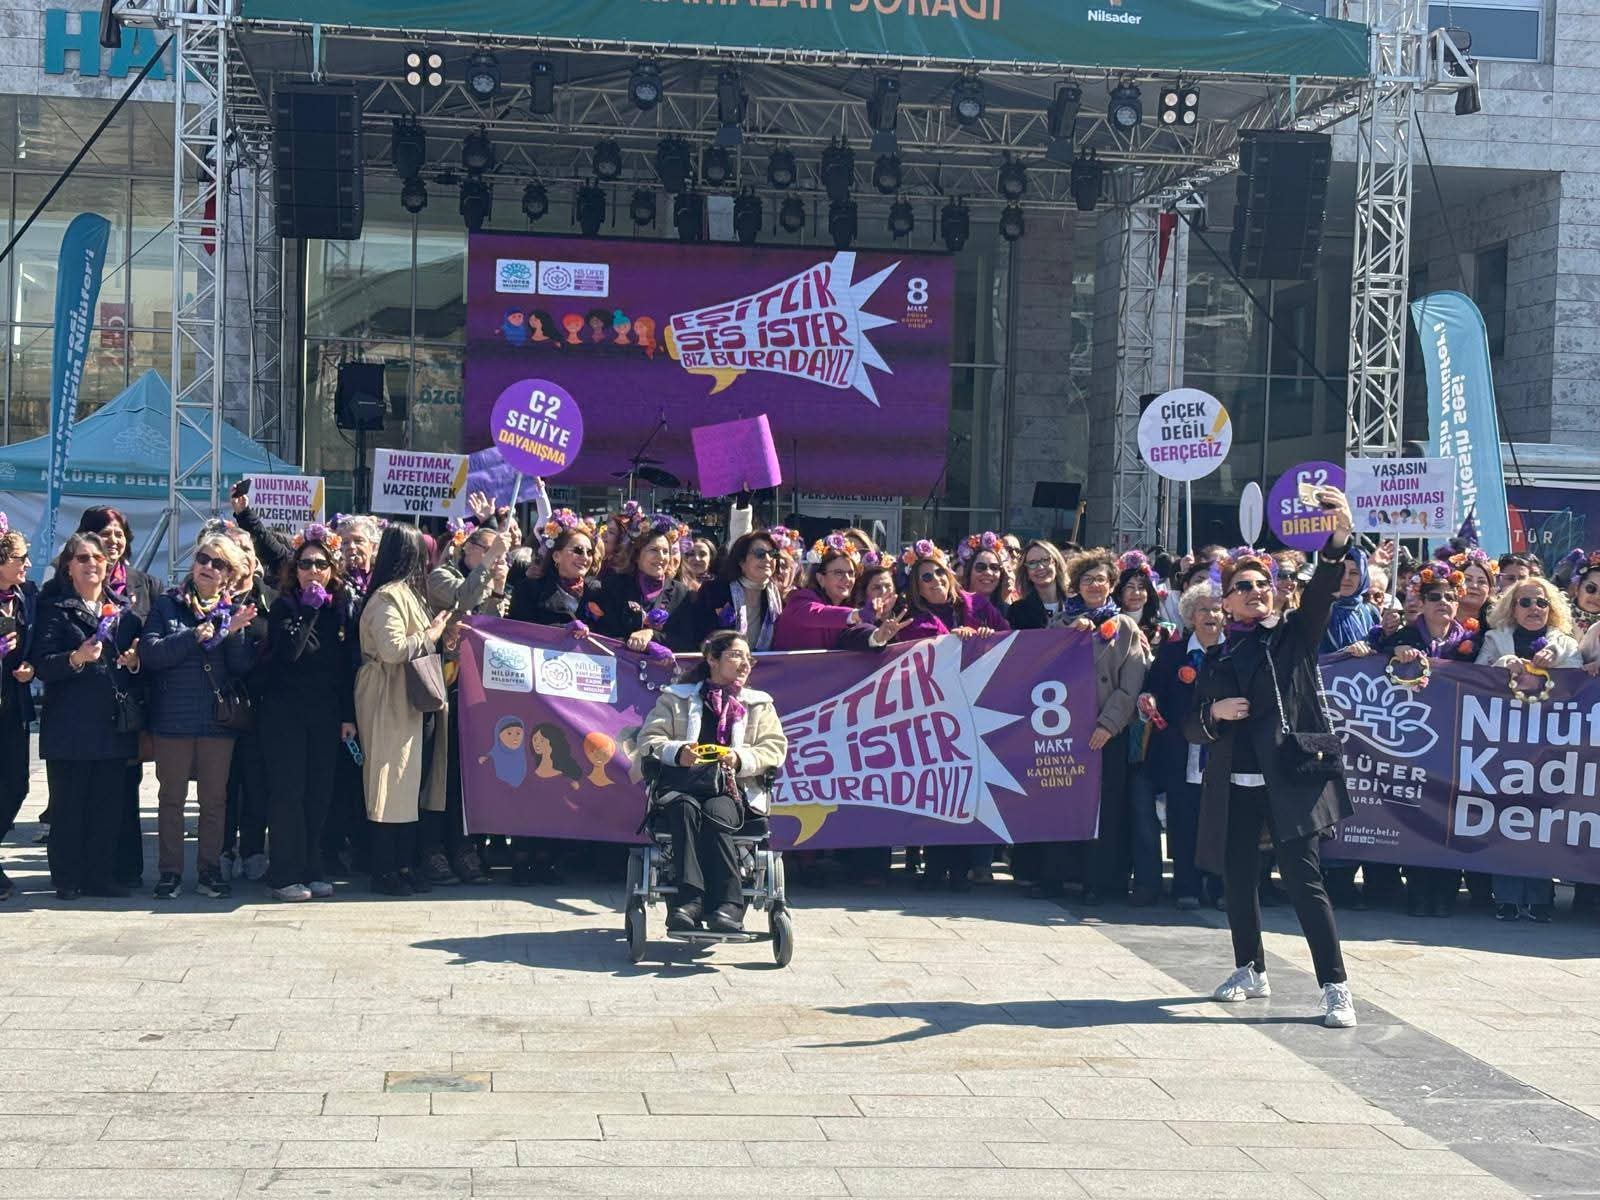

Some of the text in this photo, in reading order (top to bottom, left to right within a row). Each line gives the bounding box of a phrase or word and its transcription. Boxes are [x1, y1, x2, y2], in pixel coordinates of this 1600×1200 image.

[1087, 9, 1142, 24] Nilsader
[672, 264, 838, 331] EŞİTLİK
[906, 277, 929, 305] 8
[676, 311, 856, 352] SES İSTER
[682, 348, 855, 386] BİZ BURADAYIZ
[529, 390, 561, 420] C2
[1161, 401, 1206, 424] ÇİÇEK
[505, 409, 571, 448] SEVİYE
[1161, 420, 1208, 441] DEĞİL
[498, 429, 566, 466] DAYANIŞMA
[389, 454, 455, 471] UNUTMAK,
[1372, 462, 1427, 479] YAŞASIN
[40, 469, 117, 484] NLÜFER
[387, 469, 454, 485] AFFETMEK,
[1380, 478, 1419, 491] KADIN
[254, 478, 312, 494] UNUTMAK,
[383, 483, 456, 500] VAZGEÇMEK
[254, 493, 312, 508] AFFETMEK,
[404, 498, 433, 512] YOK!
[1356, 491, 1444, 508] DAYANIŞMASI
[1435, 506, 1444, 519] 8
[1031, 680, 1071, 736] 8
[775, 711, 972, 779] ES İSTER
[1034, 738, 1073, 754] MART
[1035, 754, 1075, 767] DÜNYA
[1026, 764, 1086, 777] KADINLAR
[1040, 774, 1073, 788] GÜNÜ
[791, 766, 973, 818] BURADAYIZ
[1344, 825, 1400, 837] nilufer.bel.tr
